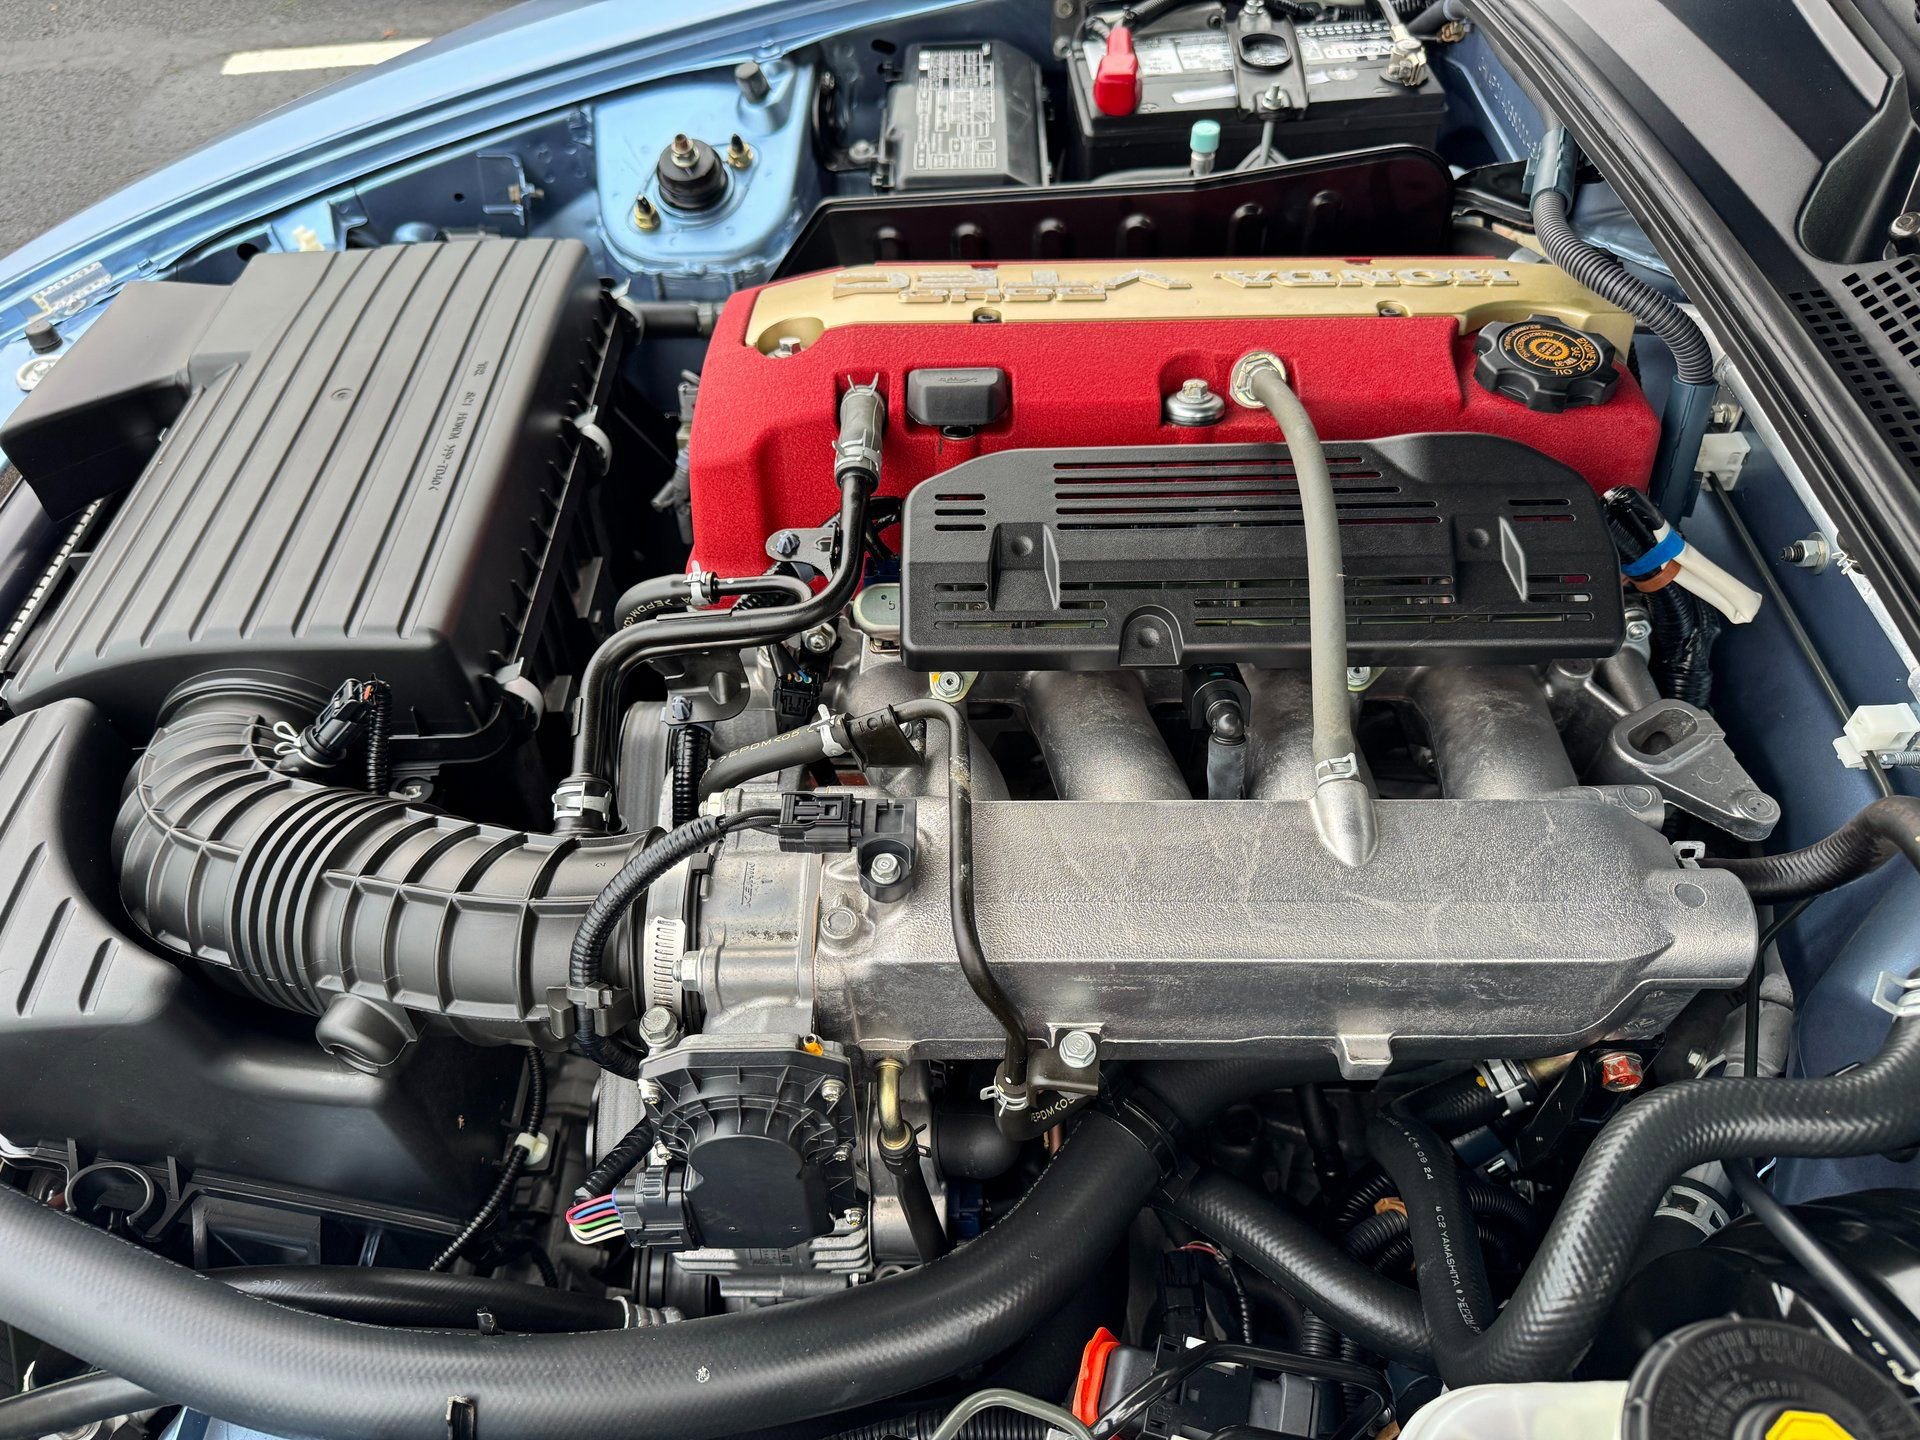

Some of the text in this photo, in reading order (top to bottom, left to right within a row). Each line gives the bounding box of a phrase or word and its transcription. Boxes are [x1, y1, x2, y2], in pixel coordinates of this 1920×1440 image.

[1211, 268, 1520, 289] HONDA
[1577, 337, 1596, 361] ENGINE
[1551, 368, 1573, 376] OIL
[1423, 1167, 1434, 1180] 24
[1440, 1230, 1461, 1287] YAMASHITA
